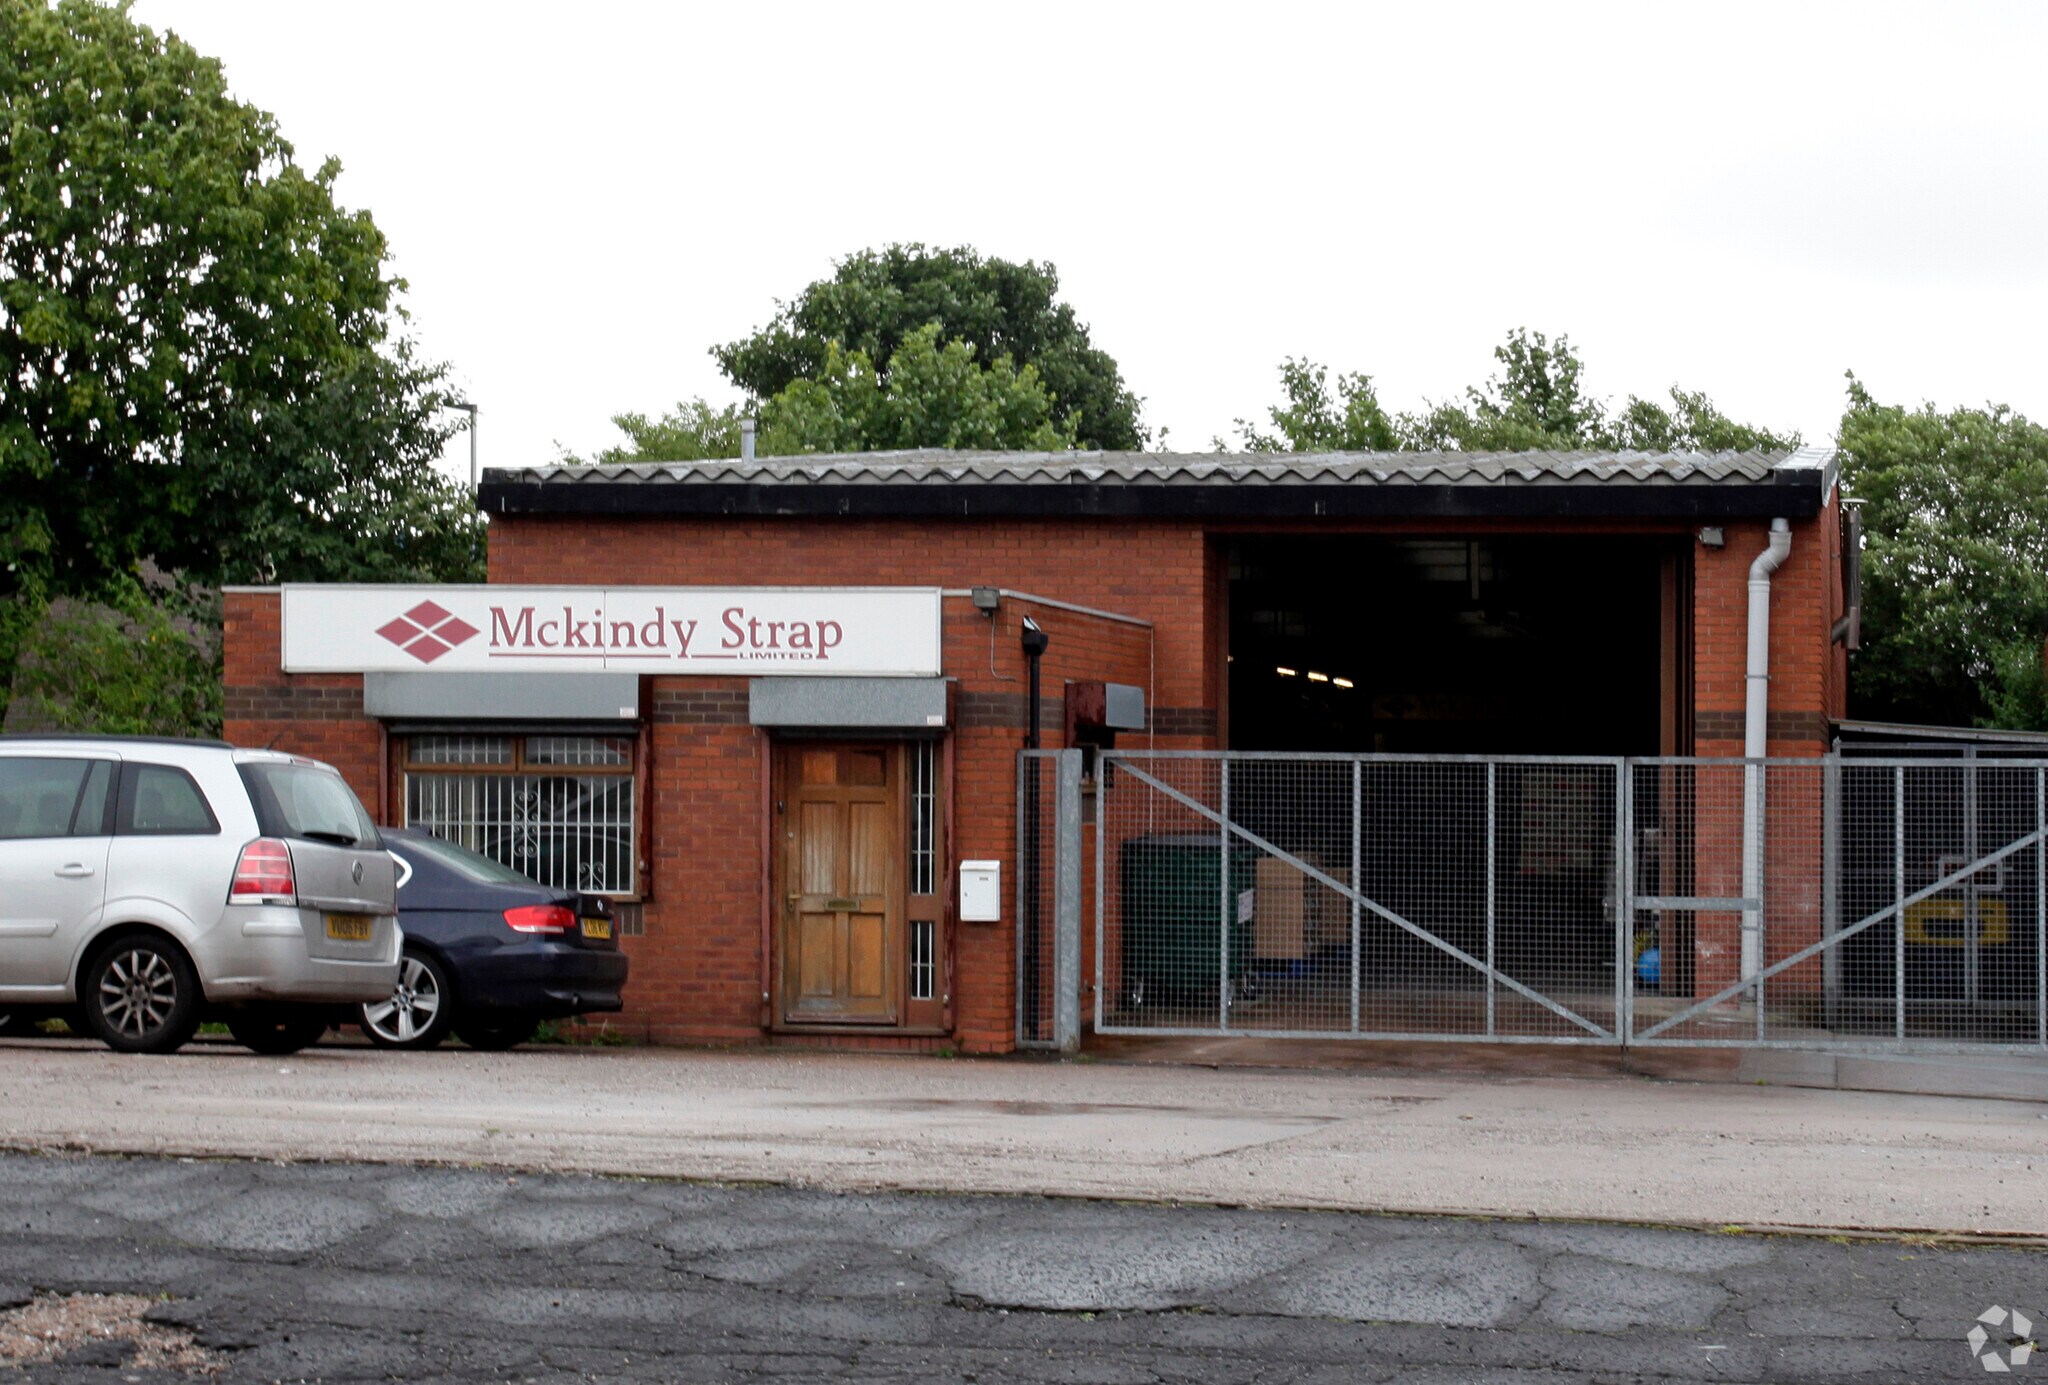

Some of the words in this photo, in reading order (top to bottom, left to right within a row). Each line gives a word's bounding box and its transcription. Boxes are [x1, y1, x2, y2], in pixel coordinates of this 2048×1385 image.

[489, 606, 698, 659] Mckindy
[721, 607, 843, 660] Strap
[739, 651, 813, 660] LIMITED
